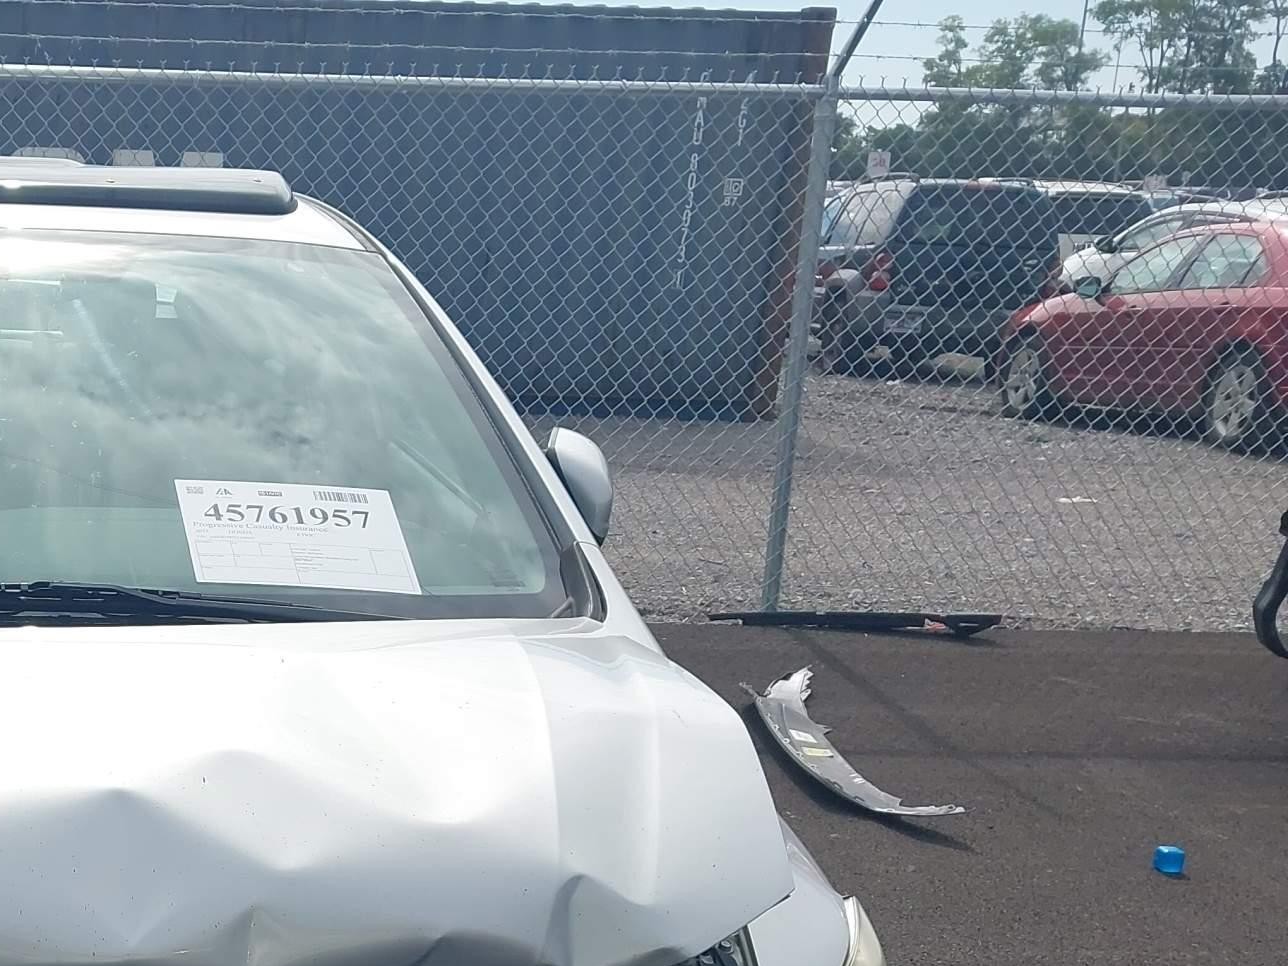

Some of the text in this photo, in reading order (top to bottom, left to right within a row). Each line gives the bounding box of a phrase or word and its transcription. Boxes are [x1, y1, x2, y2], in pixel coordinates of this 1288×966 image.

[204, 503, 369, 529] 45761957
[192, 521, 329, 533] Progressive Casualty Insurance
